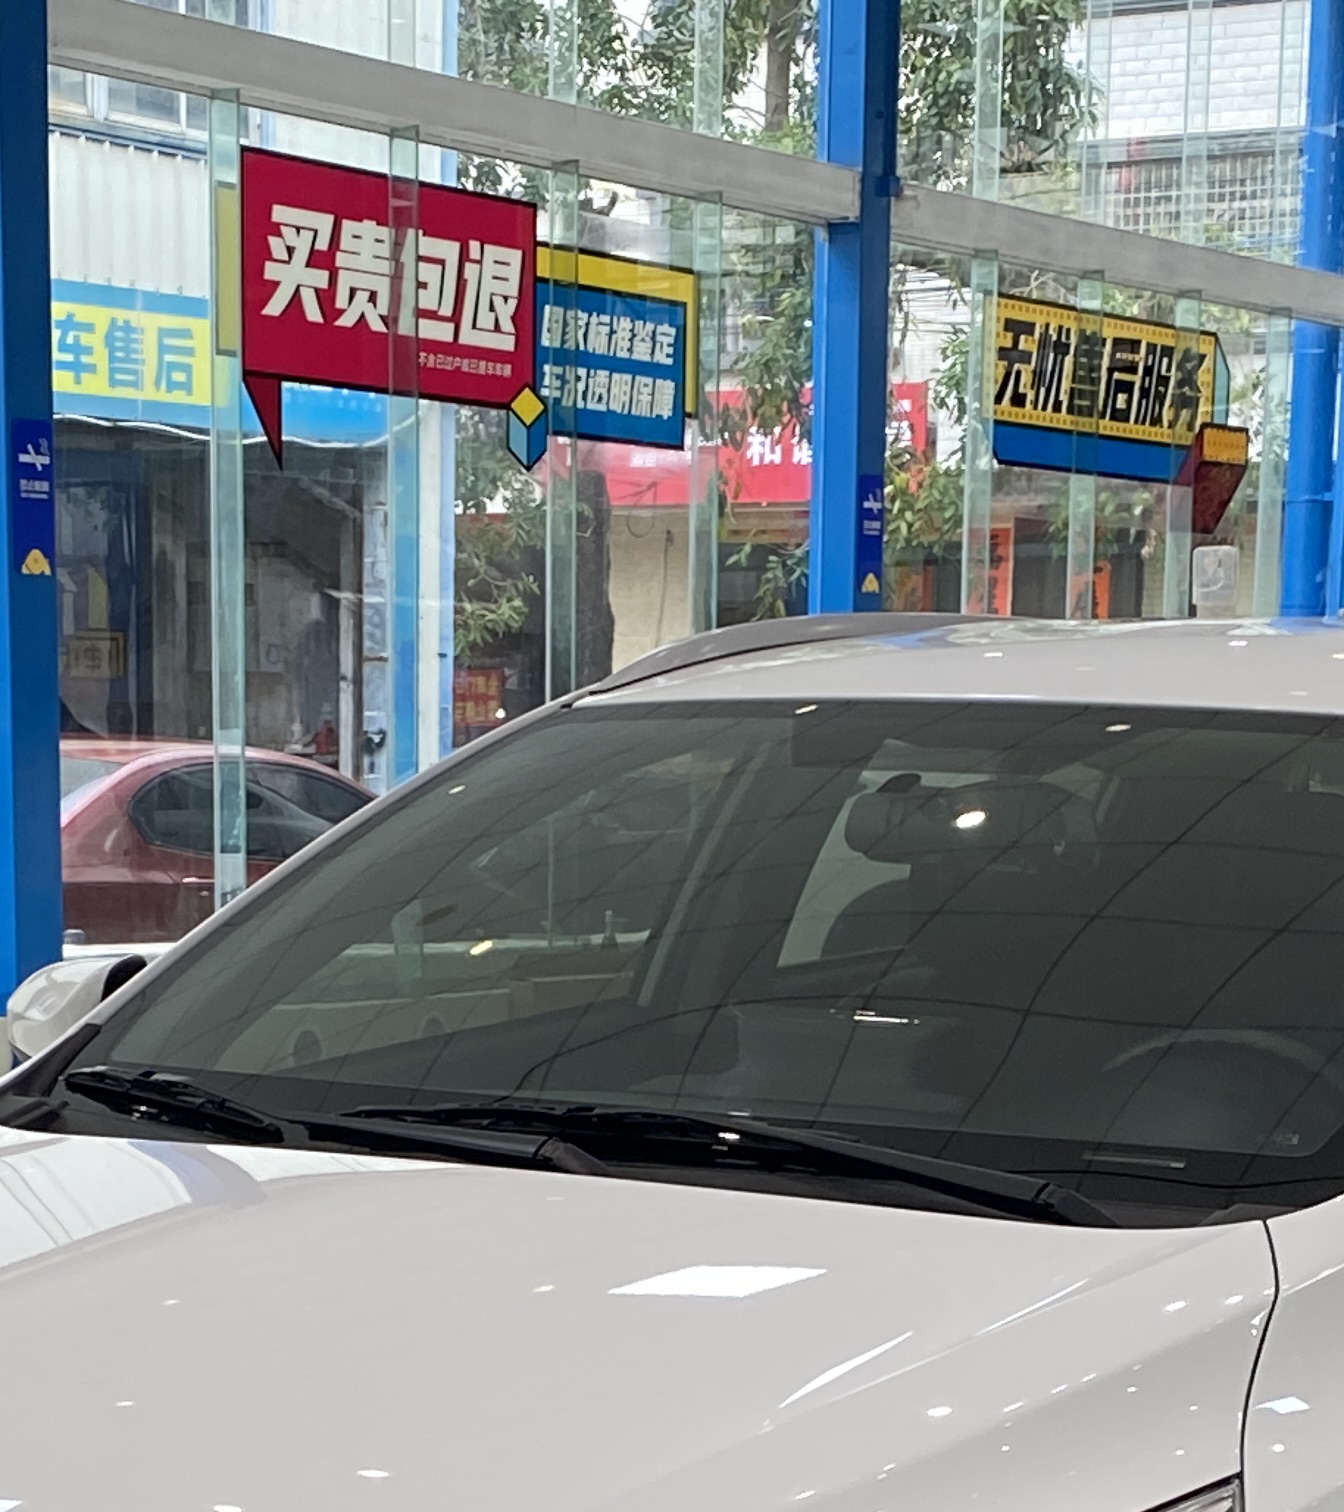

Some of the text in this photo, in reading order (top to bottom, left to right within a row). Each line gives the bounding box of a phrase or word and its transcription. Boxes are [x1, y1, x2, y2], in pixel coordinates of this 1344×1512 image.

[260, 203, 523, 352] 买贵包退
[541, 304, 677, 366] 国家标准鉴定
[994, 317, 1207, 431] 无忧售后服务
[540, 364, 676, 420] 车况透明保障
